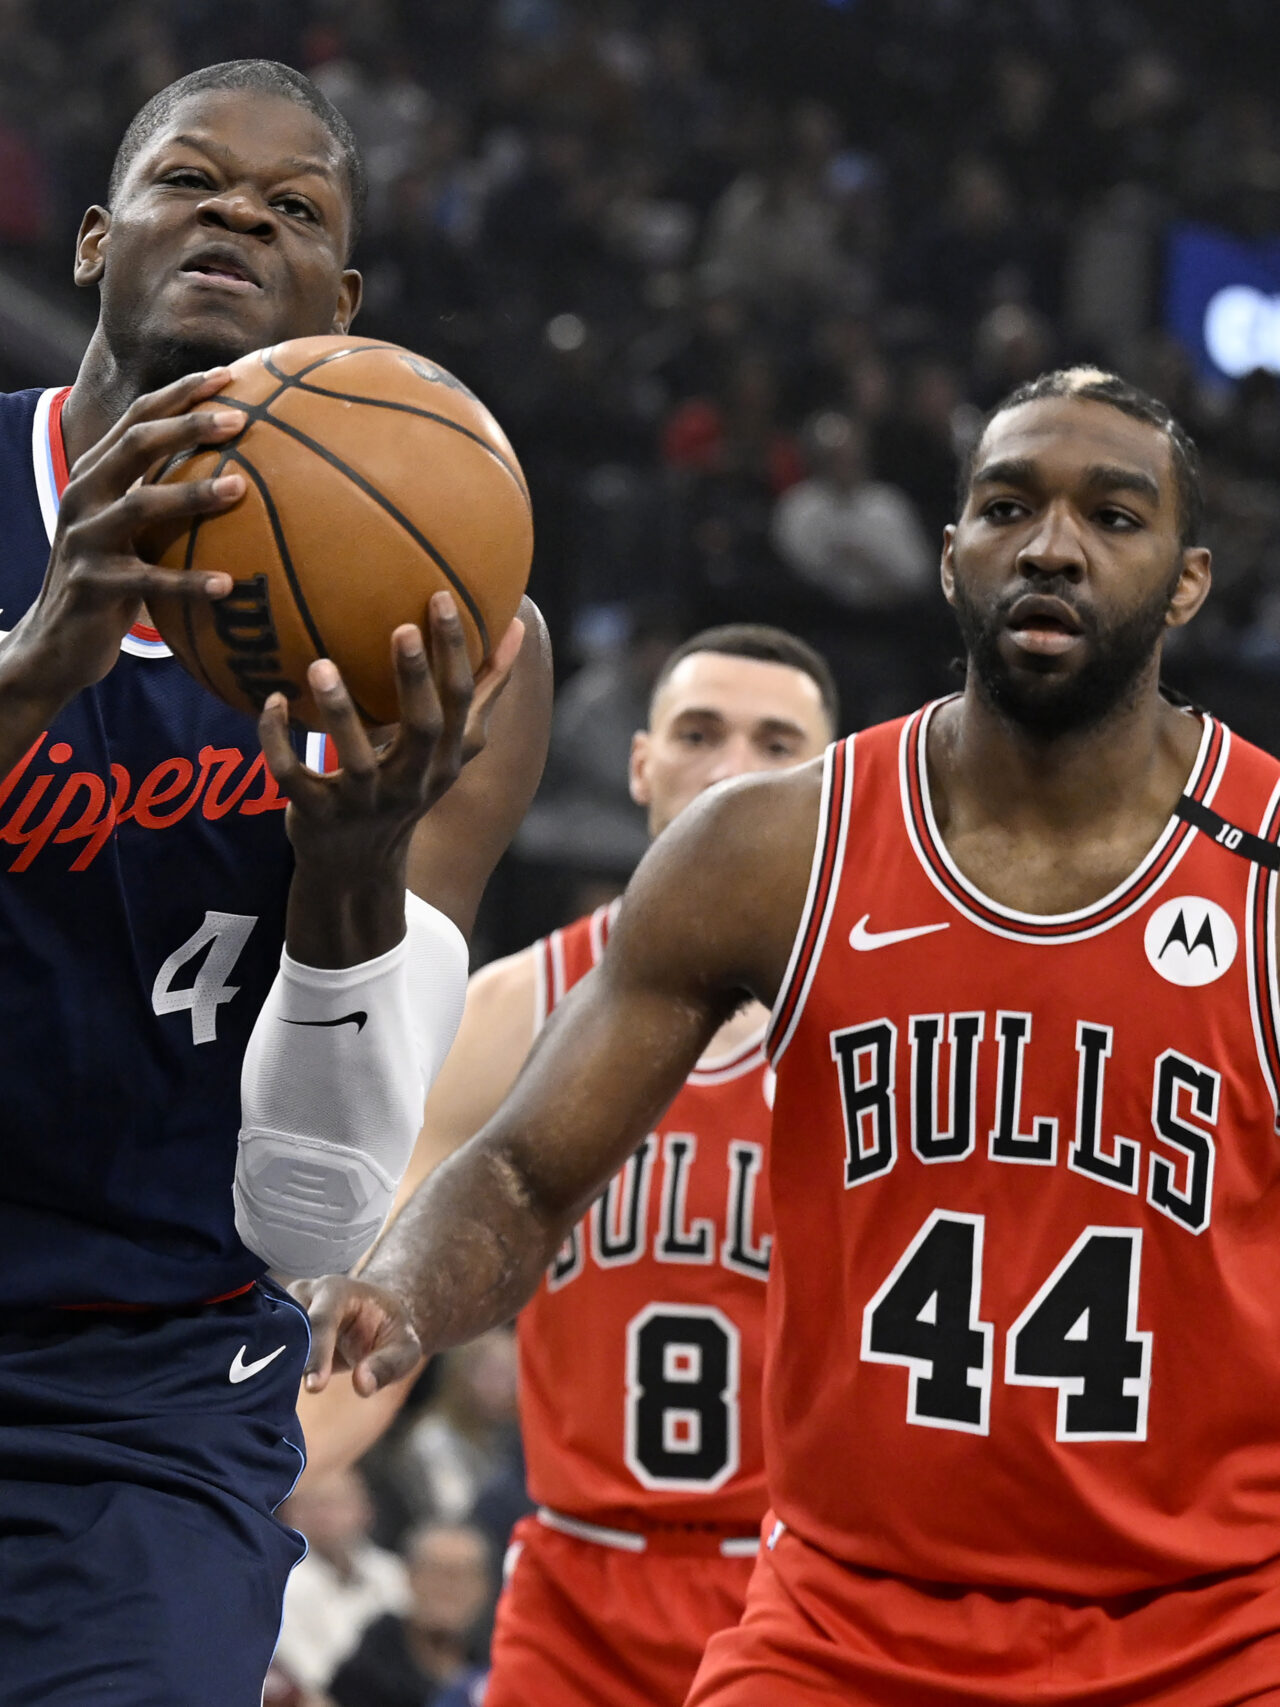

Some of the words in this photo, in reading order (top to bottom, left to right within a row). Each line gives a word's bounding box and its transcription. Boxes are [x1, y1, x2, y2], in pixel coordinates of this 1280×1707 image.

[1215, 823, 1244, 850] 10
[151, 910, 259, 1045] 4
[829, 1009, 1221, 1237] BULLS
[547, 1131, 773, 1293] ULL
[623, 1301, 740, 1494] 8
[860, 1207, 1154, 1443] 44
